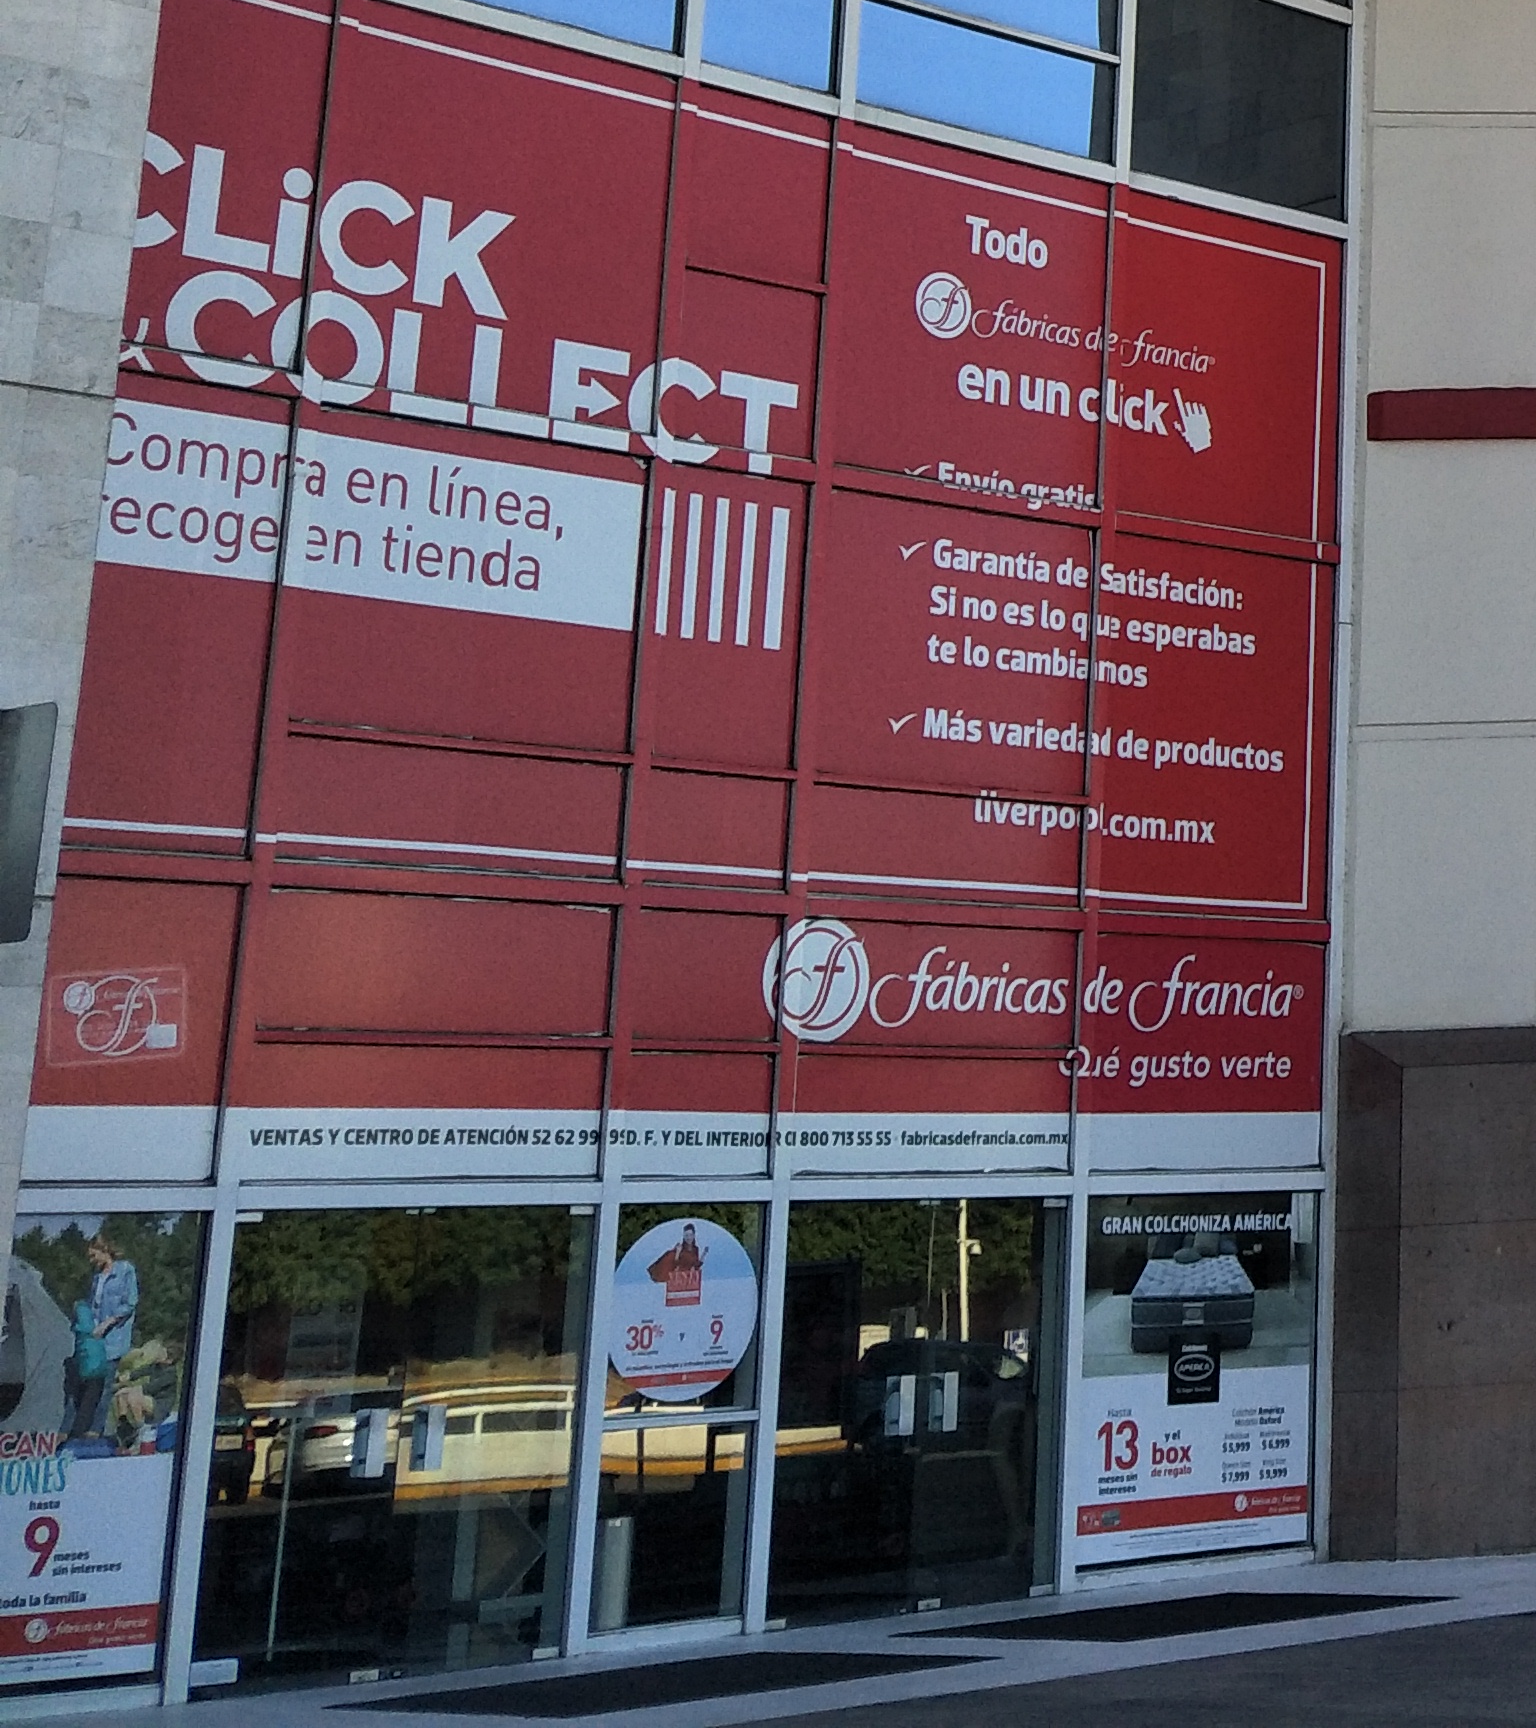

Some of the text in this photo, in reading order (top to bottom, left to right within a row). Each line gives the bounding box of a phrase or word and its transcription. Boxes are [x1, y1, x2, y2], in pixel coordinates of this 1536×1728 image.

[965, 214, 1048, 270] Todo
[1085, 326, 1119, 353] de
[165, 270, 798, 476] COLLECT
[957, 363, 1169, 436] en un click
[107, 412, 565, 543] Compra en línea,
[938, 461, 1017, 499] Envío
[102, 494, 542, 592] ecoge en tienda
[932, 538, 1049, 583] Garantía
[1056, 557, 1088, 588] de
[928, 585, 1257, 656] Si no es lo que esperabas
[927, 634, 1149, 688] te lo cambiamos
[922, 707, 1284, 773] Más variedad de productos
[973, 789, 1215, 845] liverpool.com.mx
[1084, 965, 1124, 1016] de
[1128, 1050, 1210, 1087] gusto
[1221, 1051, 1292, 1078] verte
[250, 1128, 323, 1146] VENTAS
[328, 1128, 340, 1146] Y
[344, 1128, 414, 1146] CENTRO
[418, 1129, 440, 1145] DE
[444, 1125, 528, 1145] ATENCIÓN
[532, 1129, 551, 1145] 52
[554, 1129, 574, 1145] 62
[578, 1129, 599, 1145] 99
[661, 1130, 671, 1146] Y
[674, 1130, 703, 1146] DEL
[800, 1131, 829, 1146] 800
[832, 1131, 853, 1146] 713
[856, 1131, 873, 1146] 55
[875, 1131, 892, 1146] 55
[900, 1130, 1069, 1146] fabricasdefrancia.com.mx
[1102, 1210, 1292, 1234] GRAN COLCHONIZA AMÉRICA
[710, 1320, 723, 1345] 9
[1098, 1419, 1139, 1472] 13
[1151, 1442, 1192, 1465] box
[1165, 1430, 1181, 1442] y el
[1098, 1475, 1124, 1483] meses
[1098, 1485, 1136, 1495] intereses
[1151, 1465, 1192, 1478] de regalo
[29, 1500, 61, 1511] hasta
[24, 1516, 60, 1578] 9
[53, 1551, 90, 1562] meses
[52, 1562, 122, 1576] sin intereses
[29, 1595, 40, 1606] la
[44, 1591, 87, 1604] familia
